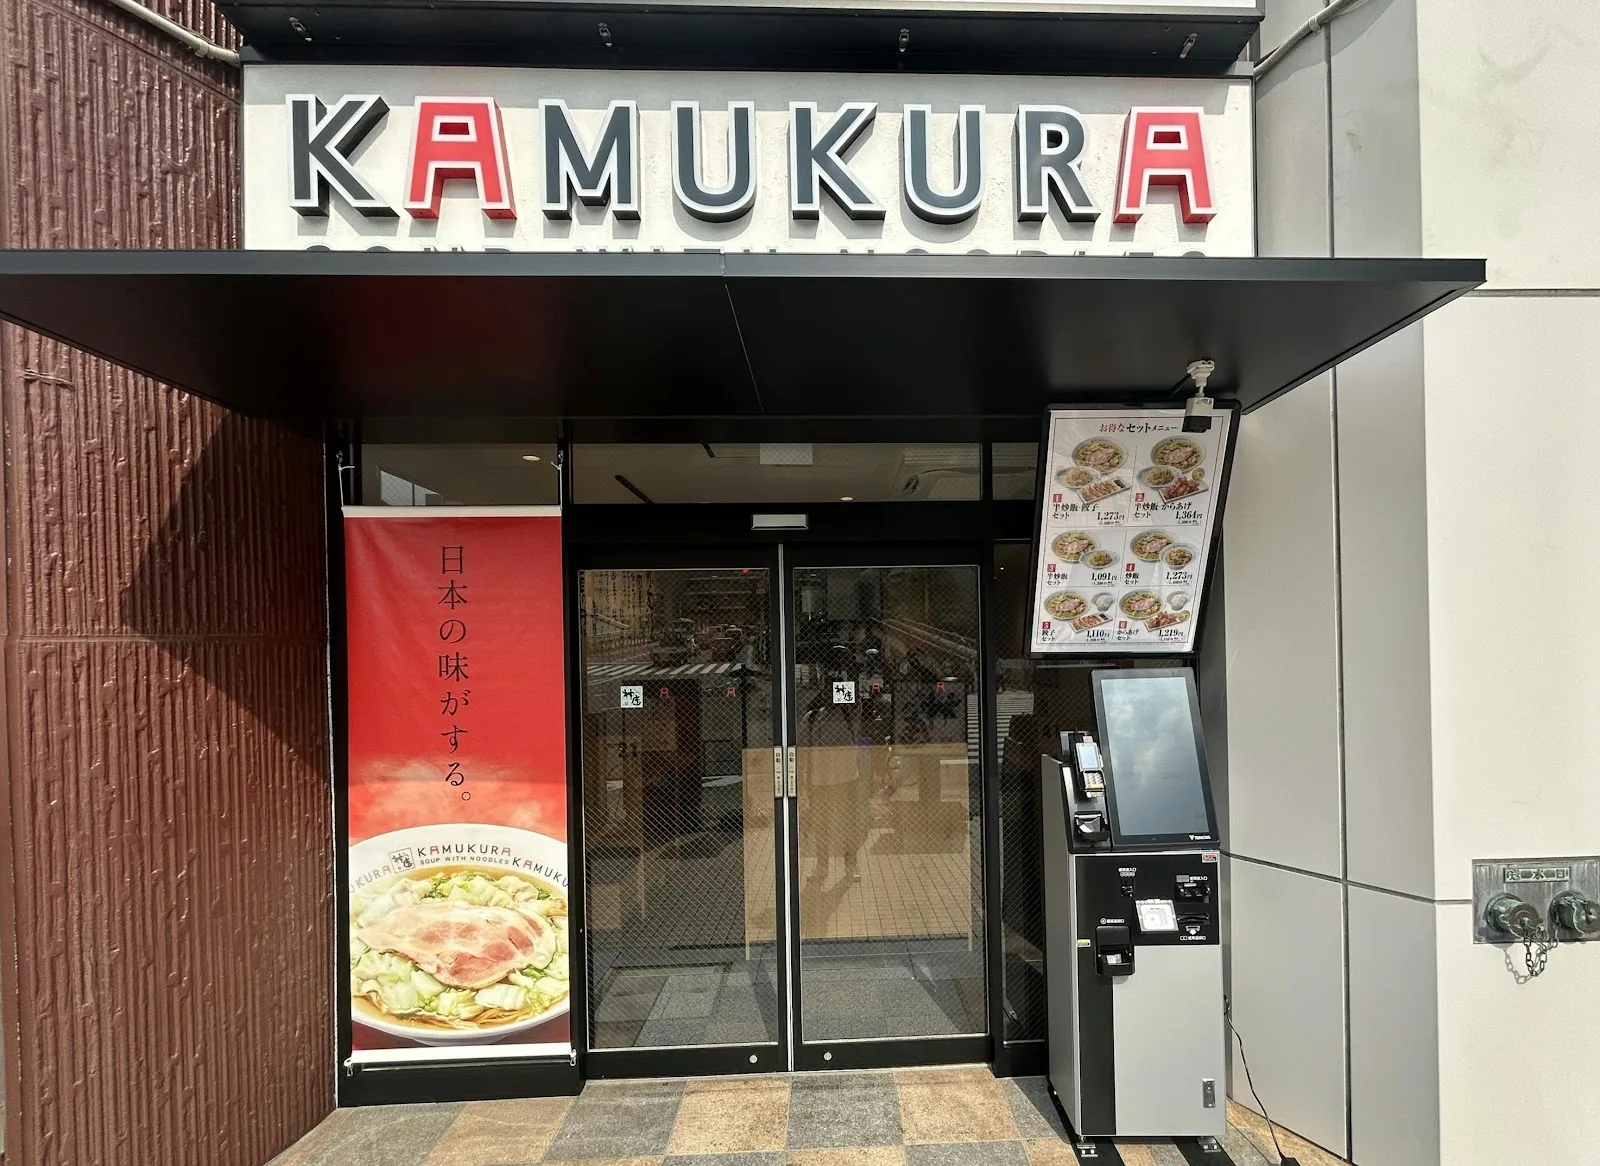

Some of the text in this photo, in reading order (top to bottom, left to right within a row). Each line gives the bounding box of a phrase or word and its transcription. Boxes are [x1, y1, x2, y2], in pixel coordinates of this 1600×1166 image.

[285, 93, 1218, 225] KAMUKURA
[1099, 422, 1178, 434] お得なセットメニュー
[437, 543, 472, 803] 日本の味がする。
[417, 843, 511, 857] KAMUKURA
[420, 857, 441, 865] SOUP
[470, 856, 509, 865] NOODLES
